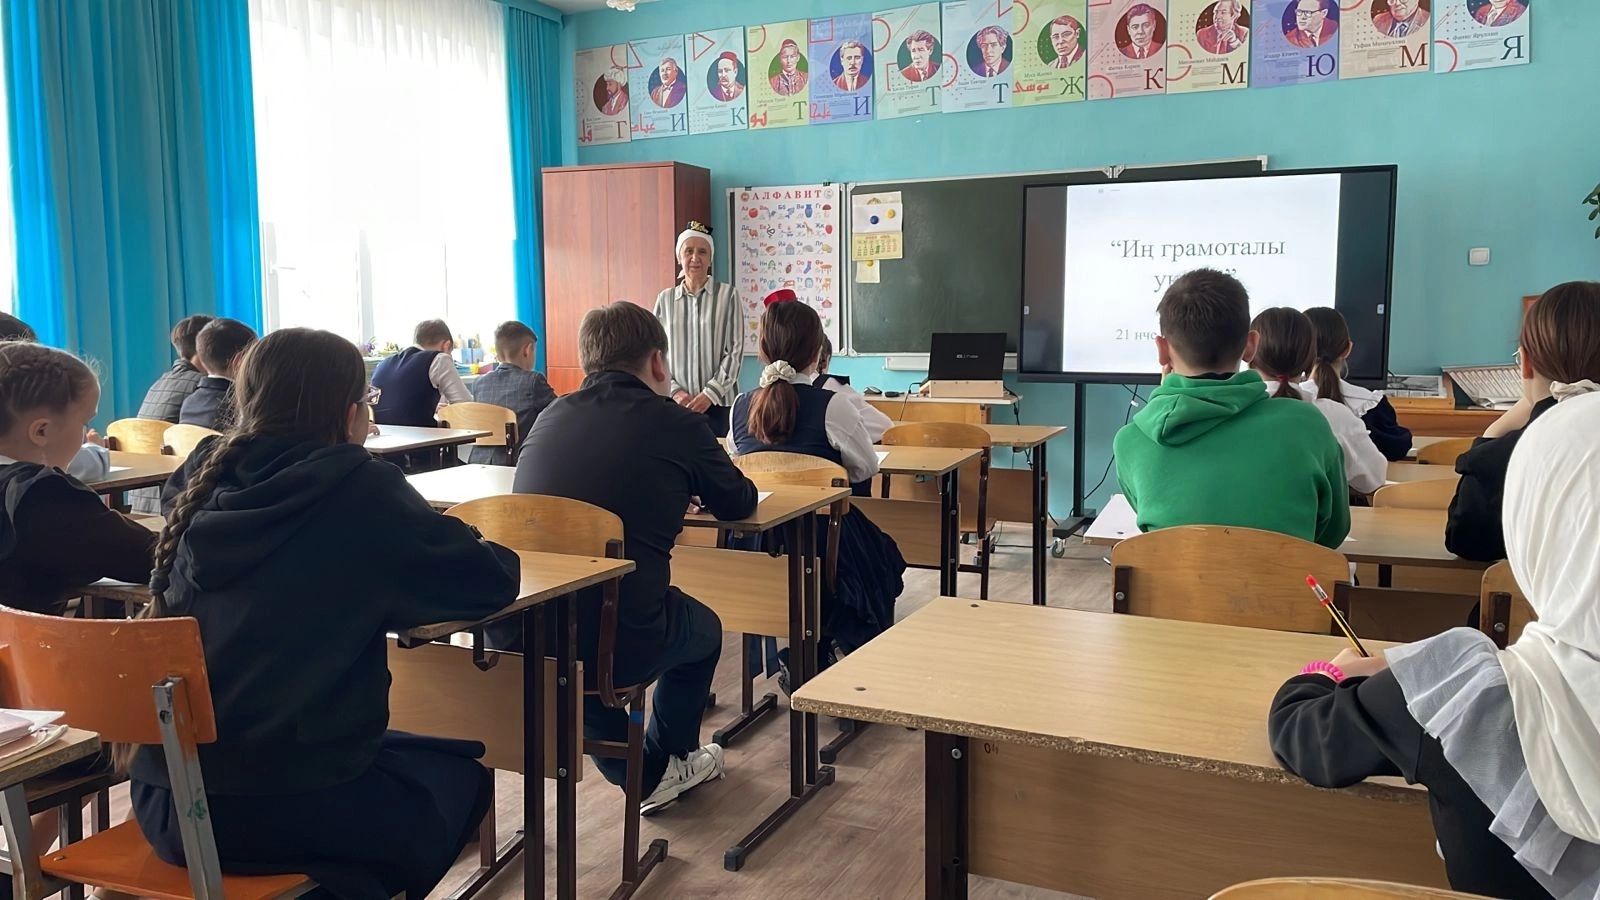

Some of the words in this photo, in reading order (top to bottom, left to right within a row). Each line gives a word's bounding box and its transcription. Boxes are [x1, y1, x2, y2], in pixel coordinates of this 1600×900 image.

[1399, 43, 1429, 69] М
[1500, 35, 1525, 61] Я
[1220, 62, 1247, 85] М
[1306, 53, 1336, 78] Ю
[1060, 76, 1085, 98] Ж
[1144, 67, 1164, 91] К
[926, 86, 942, 107] Т
[992, 83, 1009, 104] Т
[730, 106, 746, 127] К
[793, 101, 808, 120] Т
[853, 96, 871, 116] И
[616, 121, 628, 139] Г
[671, 112, 686, 132] И
[752, 189, 822, 201] АЛФАВИТ
[1110, 239, 1154, 260] “Иң
[1162, 240, 1286, 262] грамоталы
[1115, 328, 1129, 340] 21
